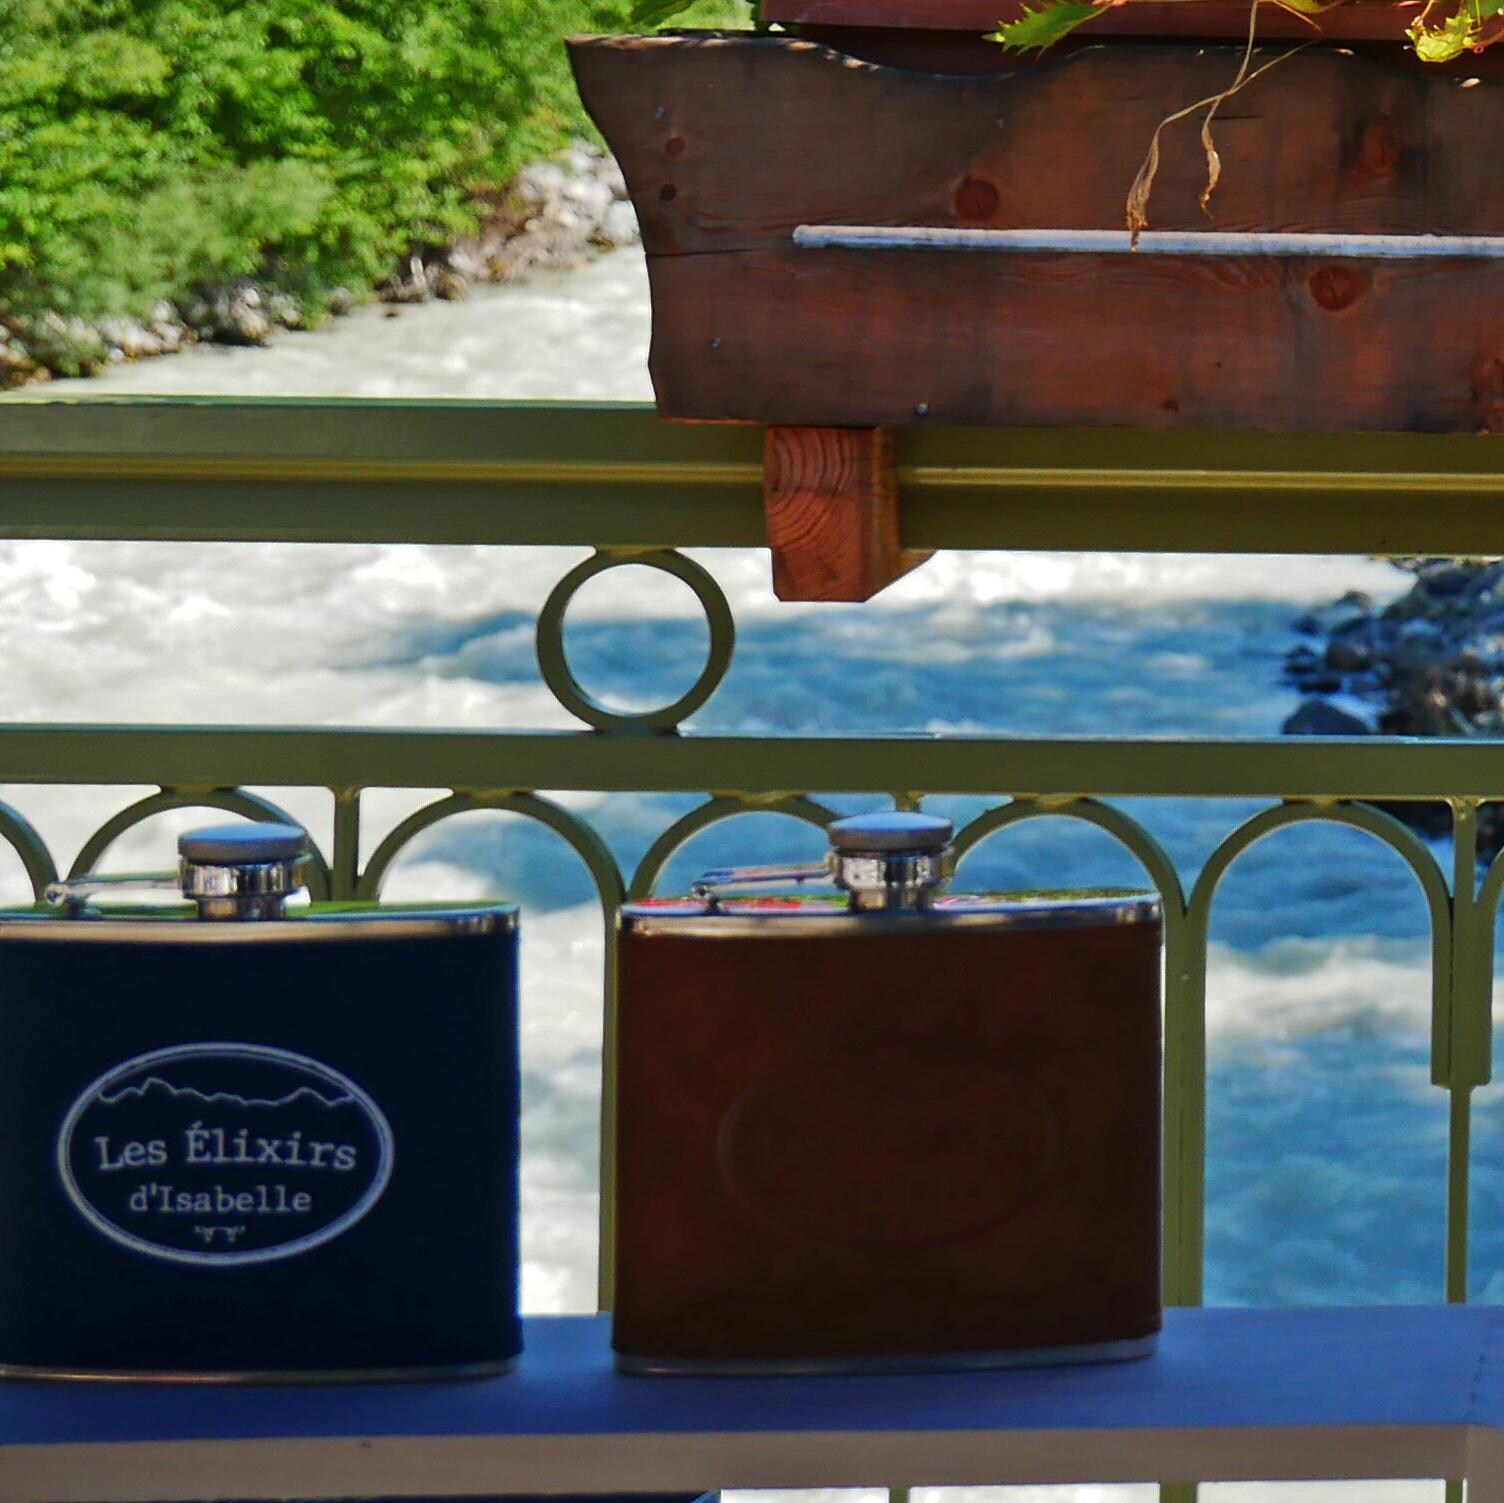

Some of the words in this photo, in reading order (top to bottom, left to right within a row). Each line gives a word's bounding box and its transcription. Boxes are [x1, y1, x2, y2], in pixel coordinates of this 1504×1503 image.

[95, 1135, 167, 1171] Les
[185, 1119, 357, 1171] Élixirs
[129, 1183, 312, 1213] d'Isabelle
